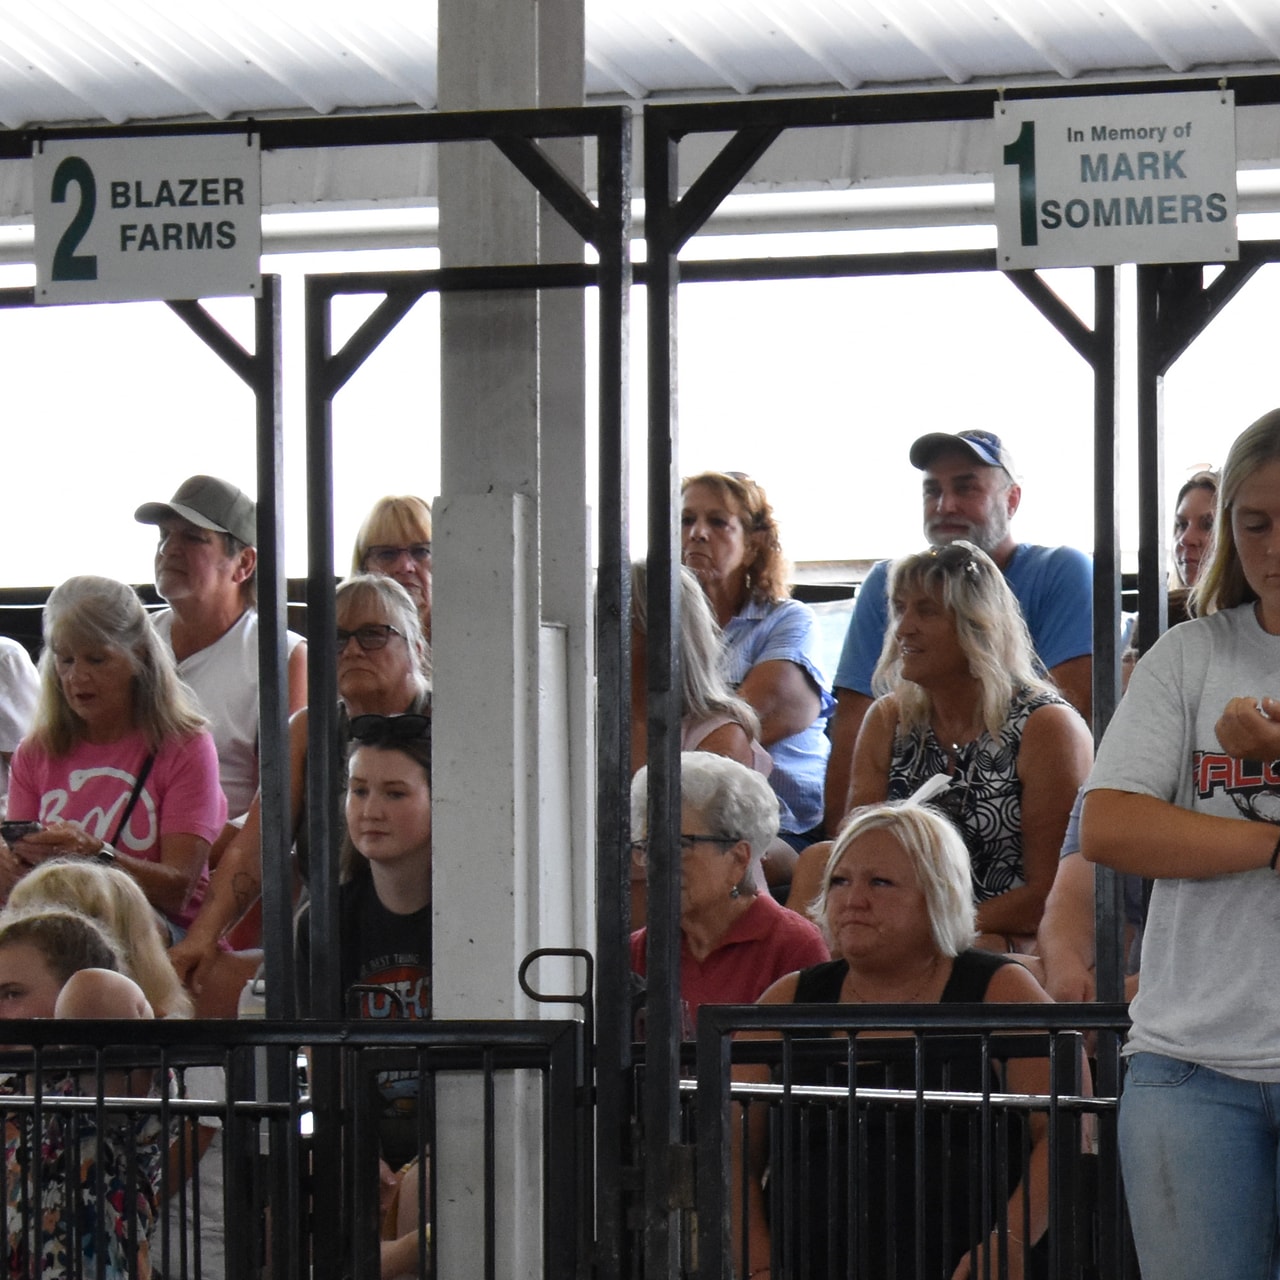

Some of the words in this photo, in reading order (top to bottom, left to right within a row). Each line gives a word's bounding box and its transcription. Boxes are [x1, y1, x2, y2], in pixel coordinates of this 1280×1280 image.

[1067, 127, 1084, 142] In
[1091, 125, 1167, 143] Memory
[1173, 121, 1192, 138] of
[1004, 120, 1038, 246] 1
[1080, 150, 1187, 183] MARK
[111, 178, 244, 209] BLAZER
[51, 156, 97, 281] 2
[1040, 192, 1227, 230] SOMMERS
[120, 221, 237, 251] FARMS
